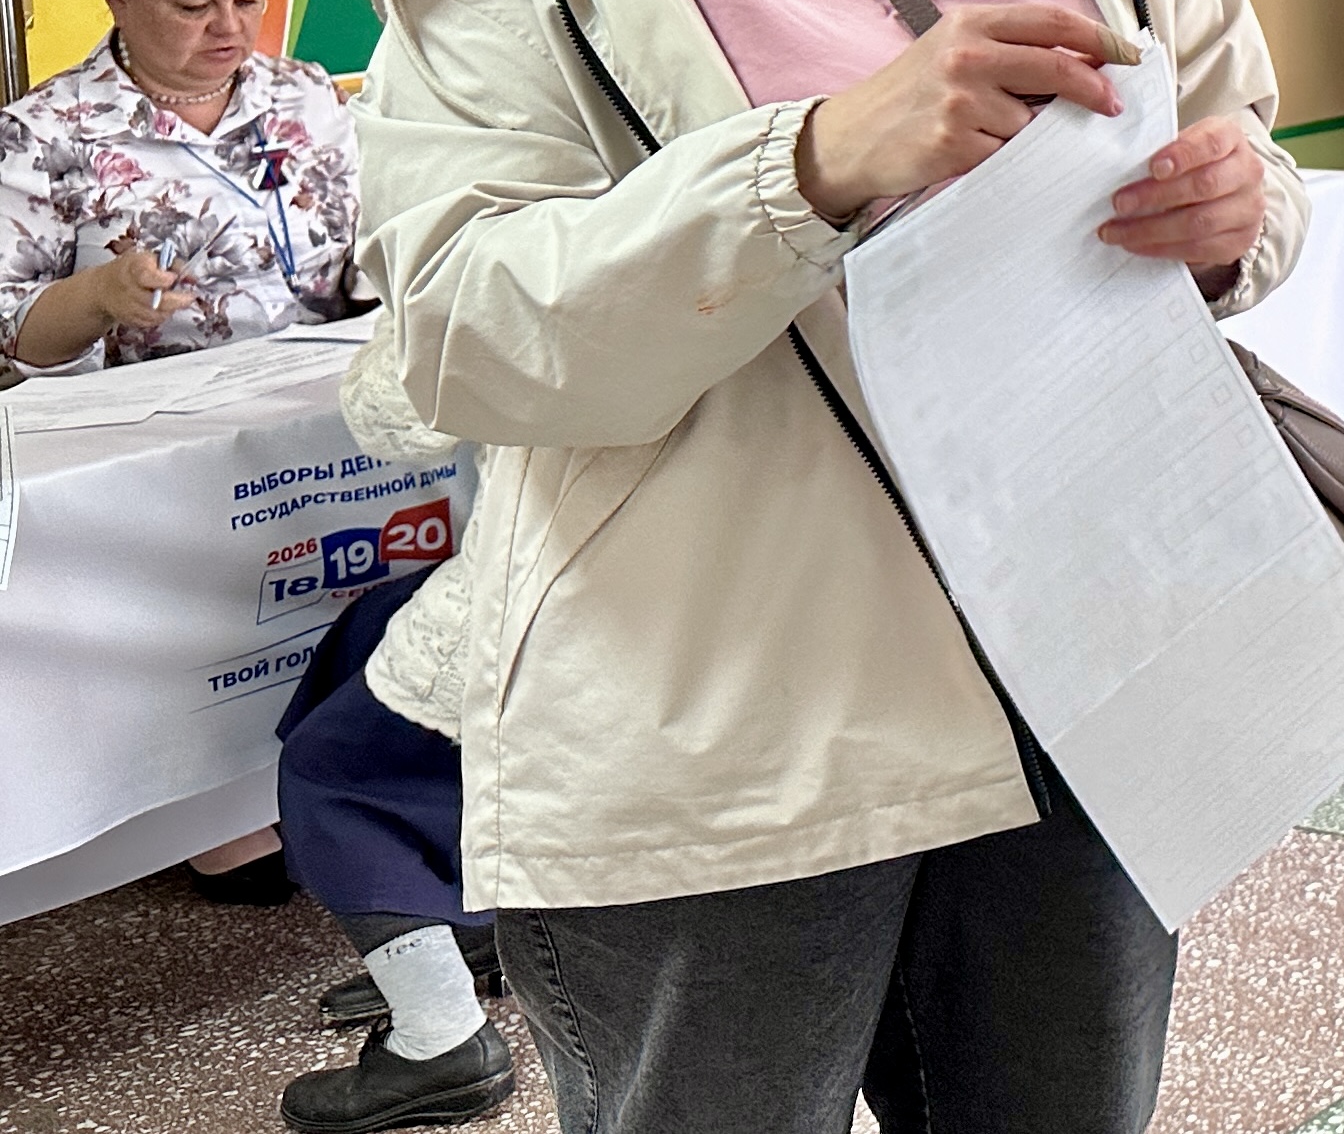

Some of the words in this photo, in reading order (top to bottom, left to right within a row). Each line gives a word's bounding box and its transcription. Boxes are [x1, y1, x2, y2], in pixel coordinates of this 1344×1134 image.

[231, 471, 416, 530] ГОСУДАРСТВЕННОЙ
[420, 463, 457, 488] ДУМЫ
[233, 463, 335, 501] ВЫБОРЫ
[267, 537, 318, 566] 2026
[269, 576, 319, 602] 18
[329, 540, 375, 581] 19
[386, 516, 448, 552] 20
[208, 659, 269, 692] ТВОЙ
[275, 645, 318, 672] ГОЛ
